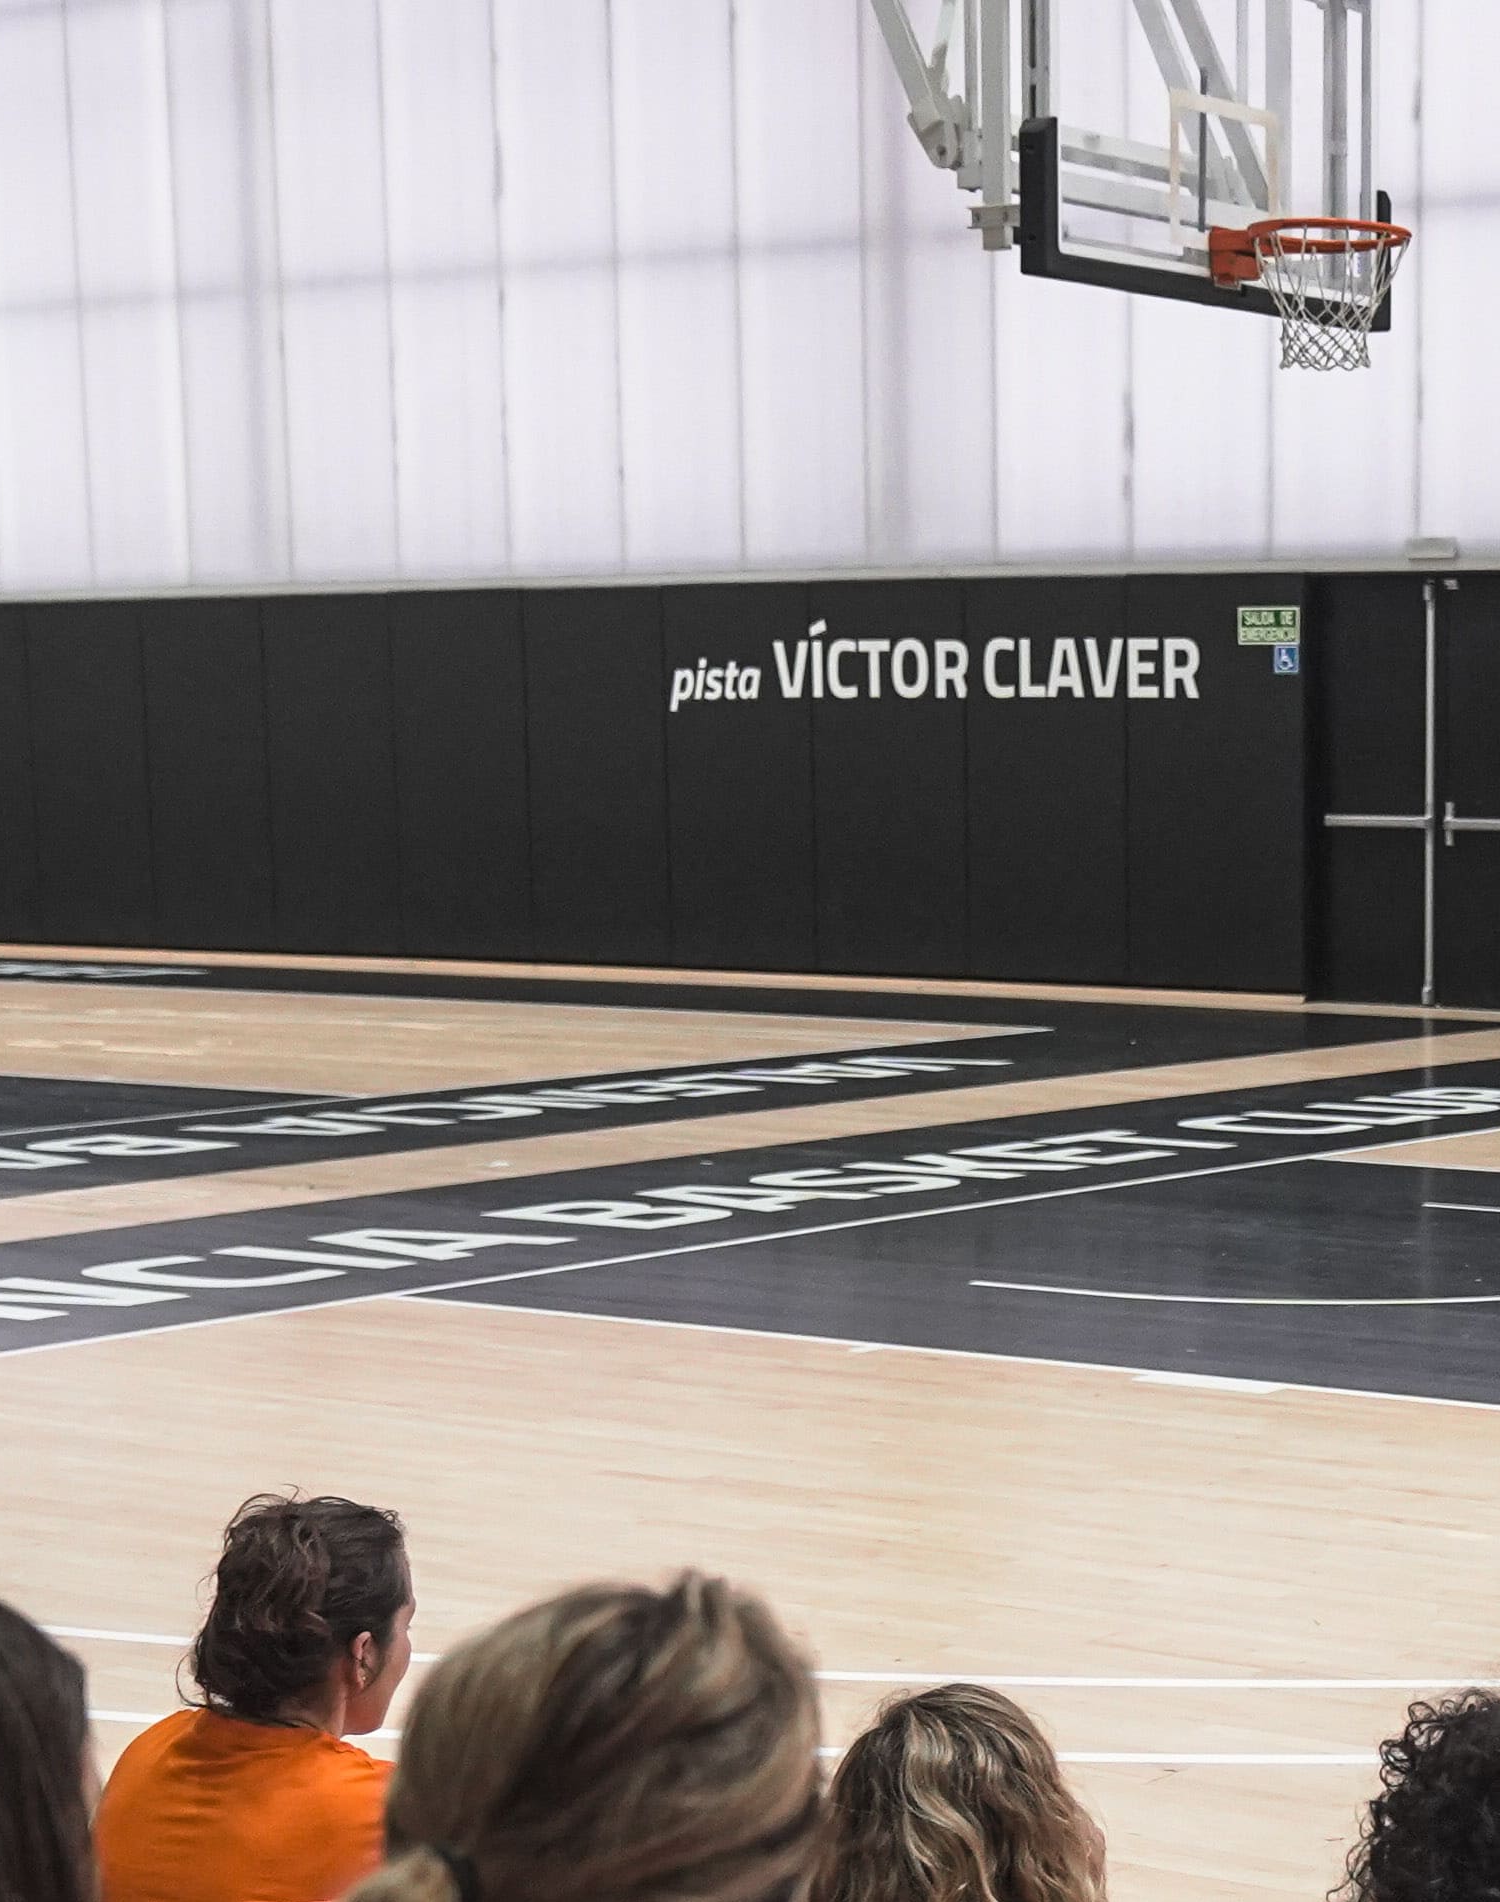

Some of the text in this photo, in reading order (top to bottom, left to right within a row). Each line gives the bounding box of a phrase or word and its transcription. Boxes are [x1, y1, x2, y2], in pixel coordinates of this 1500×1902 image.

[670, 619, 1200, 712] pista VÍCTOR CLAVER
[177, 1057, 1015, 1137] VALENCIA
[480, 1128, 1239, 1231] BASKET
